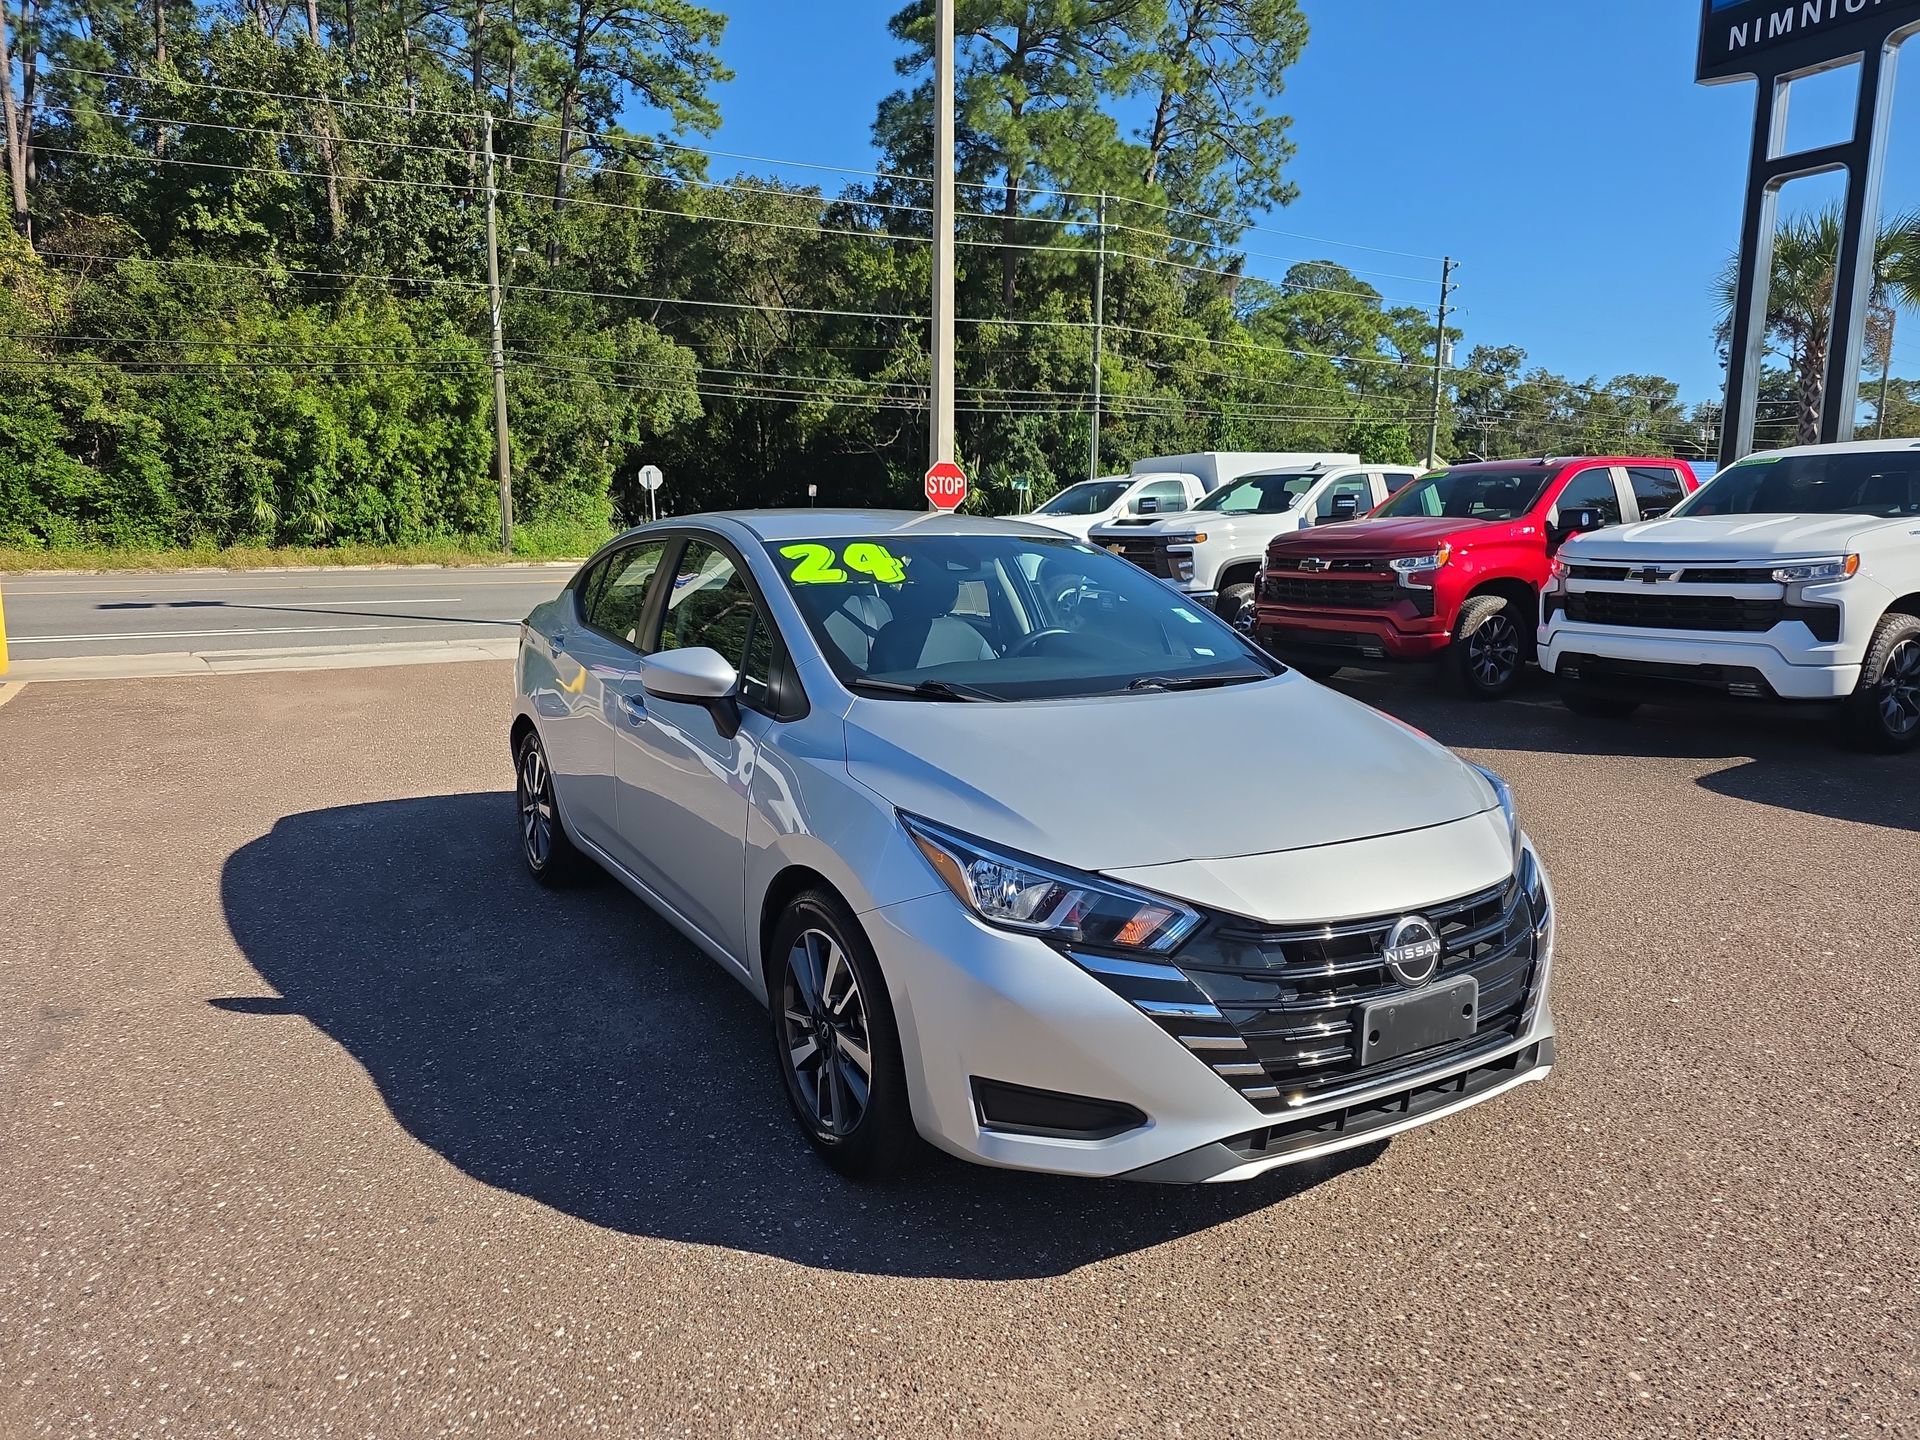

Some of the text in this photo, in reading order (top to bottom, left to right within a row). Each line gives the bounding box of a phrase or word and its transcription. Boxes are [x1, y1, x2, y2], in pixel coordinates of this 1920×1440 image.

[1728, 0, 1882, 51] NIMNI
[928, 476, 964, 495] STOP
[779, 543, 906, 584] 24
[1386, 940, 1440, 962] NISSAN
